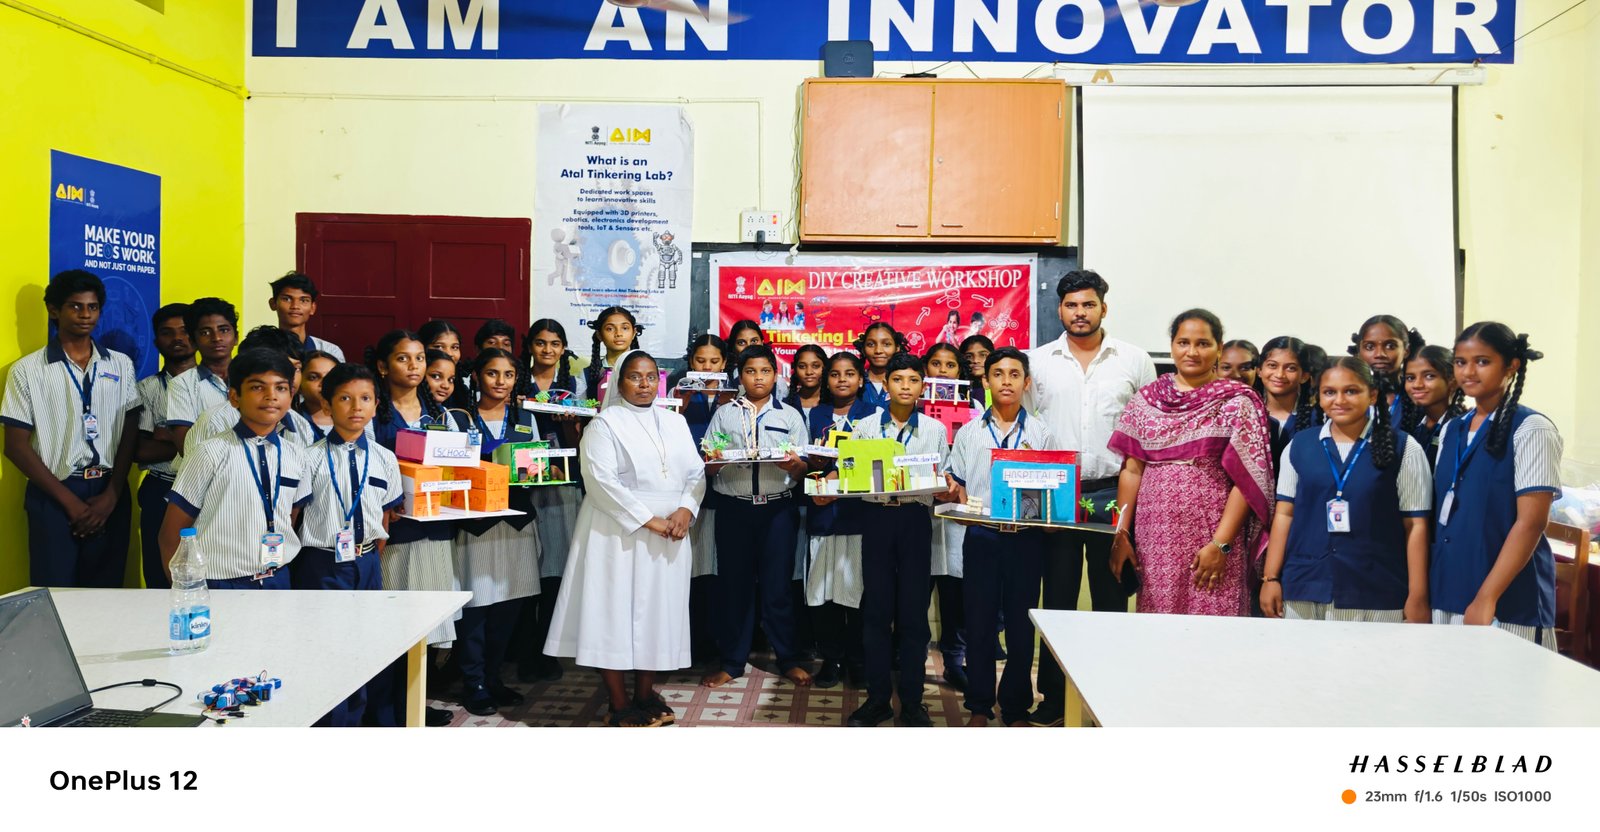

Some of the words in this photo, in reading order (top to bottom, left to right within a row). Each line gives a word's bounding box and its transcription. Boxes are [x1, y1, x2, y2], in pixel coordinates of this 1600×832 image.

[276, 0, 298, 48] I
[346, 0, 499, 50] AM
[583, 0, 729, 52] AN
[827, 0, 1502, 55] INNOVATOR
[587, 156, 616, 165] What
[620, 156, 629, 165] is
[633, 158, 648, 166] an
[561, 169, 584, 178] Atal
[588, 169, 641, 182] Tinkering
[646, 171, 673, 181] Lab?
[627, 218, 668, 226] development
[84, 224, 121, 245] MAKE
[122, 230, 156, 250] YOUR
[121, 247, 156, 265] WORK.
[84, 259, 98, 268] AND
[98, 261, 112, 270] NOT
[112, 263, 126, 272] JUST
[137, 266, 156, 275] PAPER.
[809, 272, 839, 290] DIY
[841, 271, 921, 290] CREATIVE
[926, 269, 1023, 288] WORKSHOP
[766, 328, 844, 346] Tinkering
